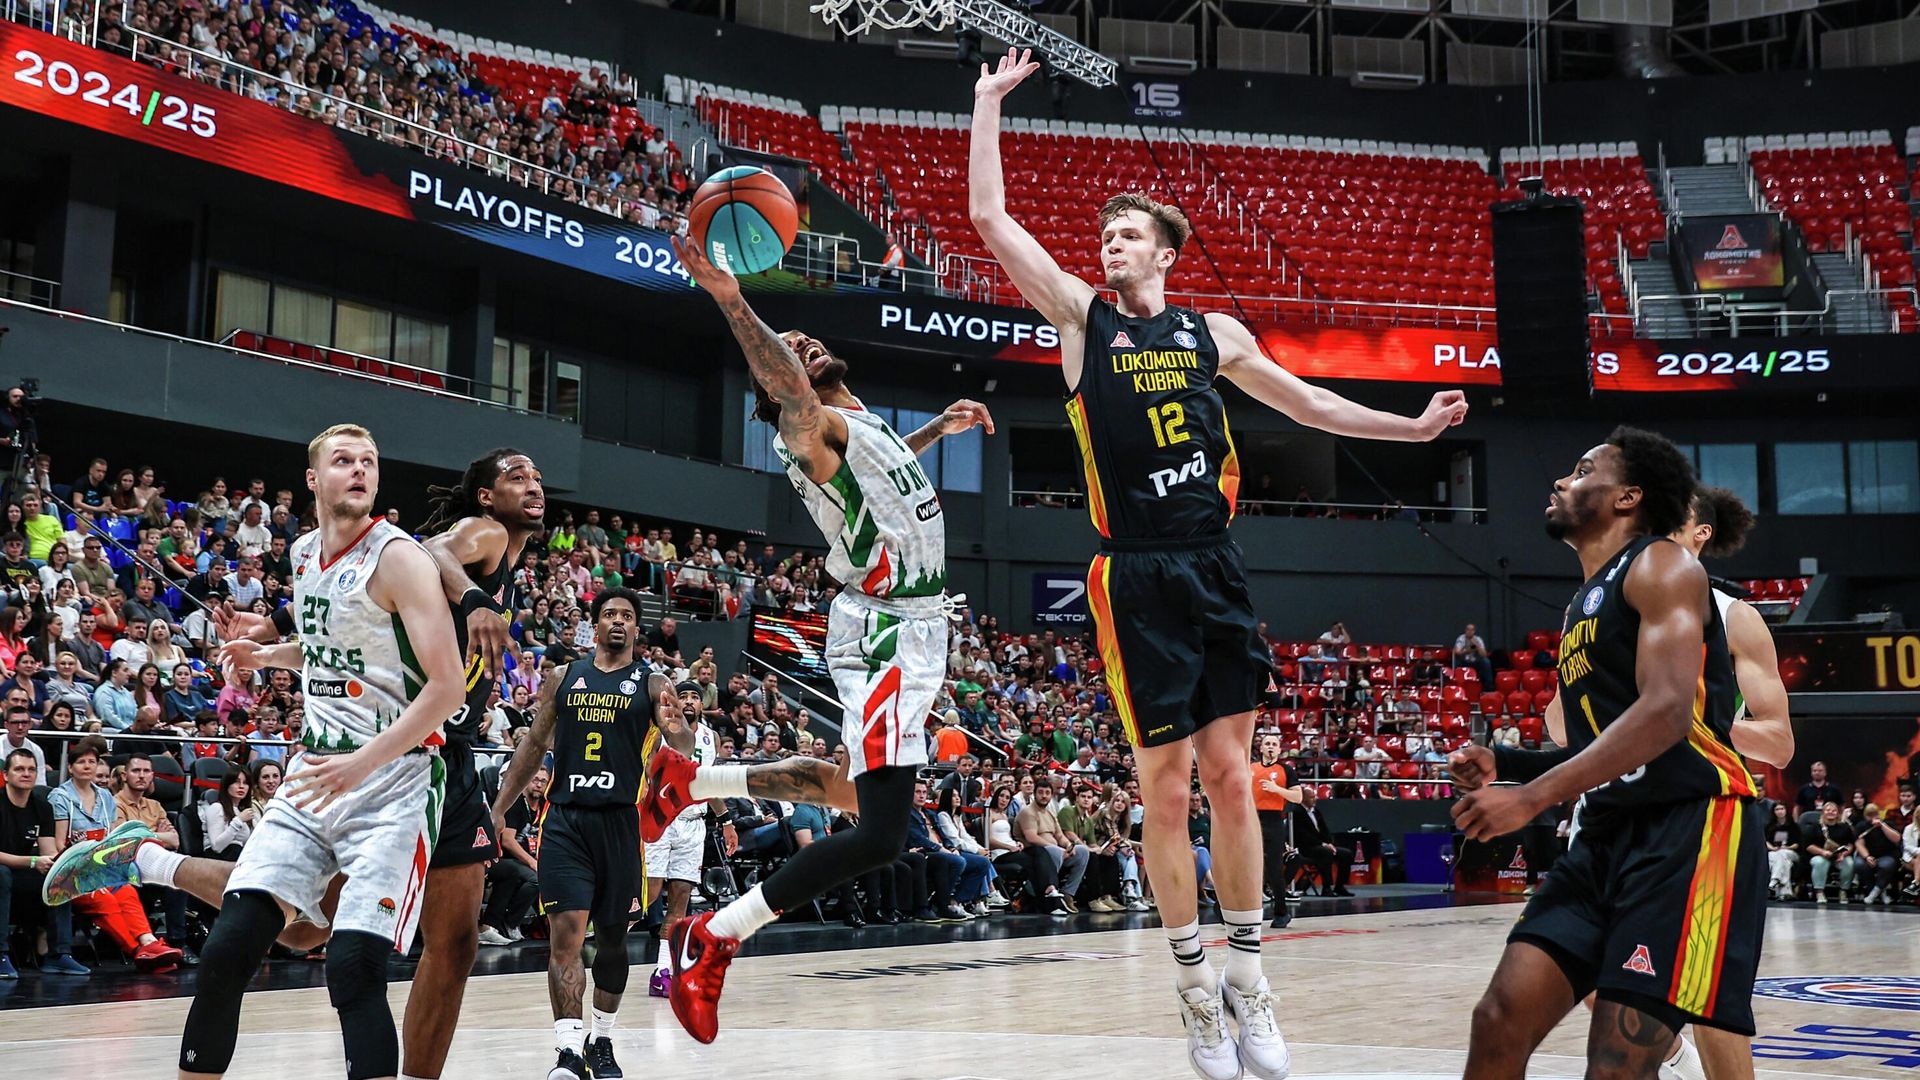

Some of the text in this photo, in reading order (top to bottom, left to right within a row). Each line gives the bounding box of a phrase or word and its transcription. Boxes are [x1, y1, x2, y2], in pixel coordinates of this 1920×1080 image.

[14, 50, 217, 138] 2024/25
[1132, 82, 1180, 107] 16
[409, 170, 585, 248] PLAYOFFS
[881, 304, 1059, 348] PLAYOFFS
[1112, 351, 1199, 373] LOKOMOTIV
[1656, 350, 1830, 376] 2024/25
[1133, 371, 1189, 393] KUBAN
[1147, 402, 1190, 448] 12
[1046, 579, 1085, 609] 7
[303, 594, 331, 636] 27
[567, 693, 632, 709] LOKOMOTIV
[577, 707, 616, 723] KUBAN
[585, 732, 602, 761] 2
